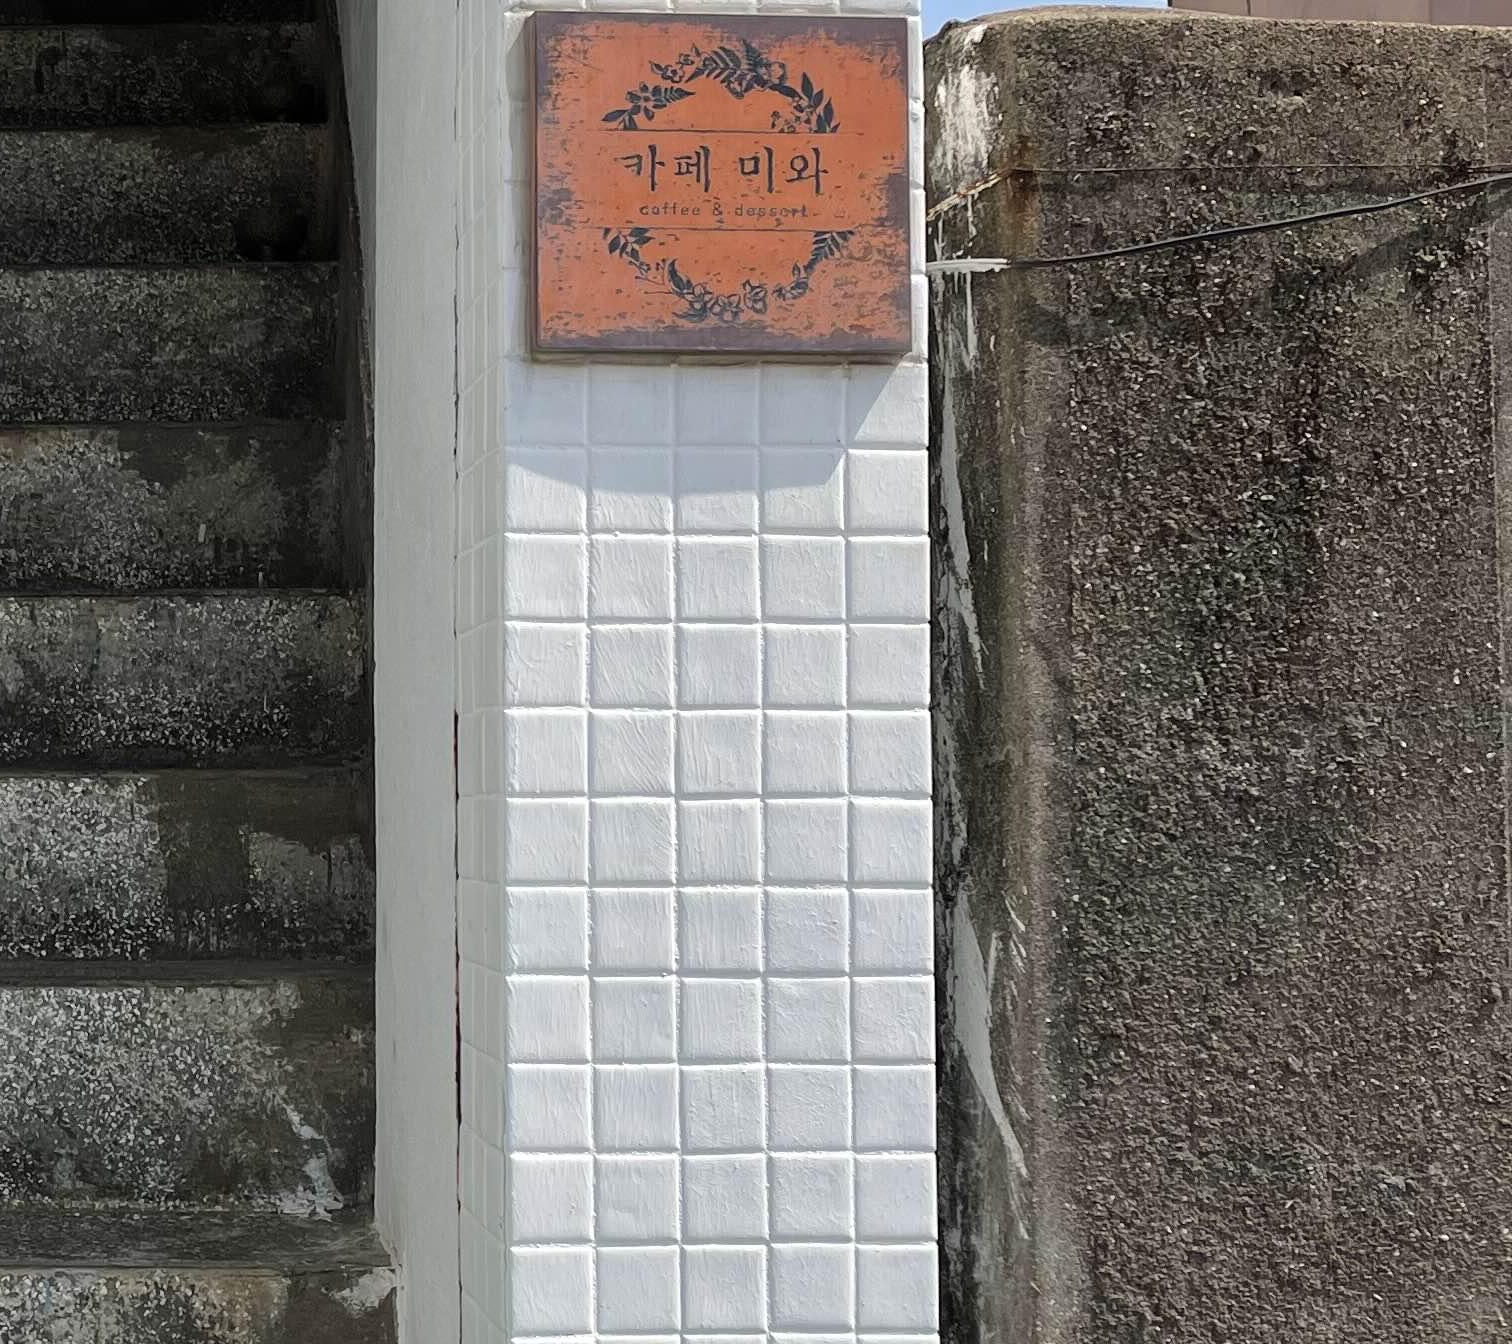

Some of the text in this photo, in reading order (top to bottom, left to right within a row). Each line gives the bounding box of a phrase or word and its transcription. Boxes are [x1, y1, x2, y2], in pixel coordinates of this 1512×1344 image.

[617, 144, 829, 194] 카페 미와
[712, 202, 723, 216] &
